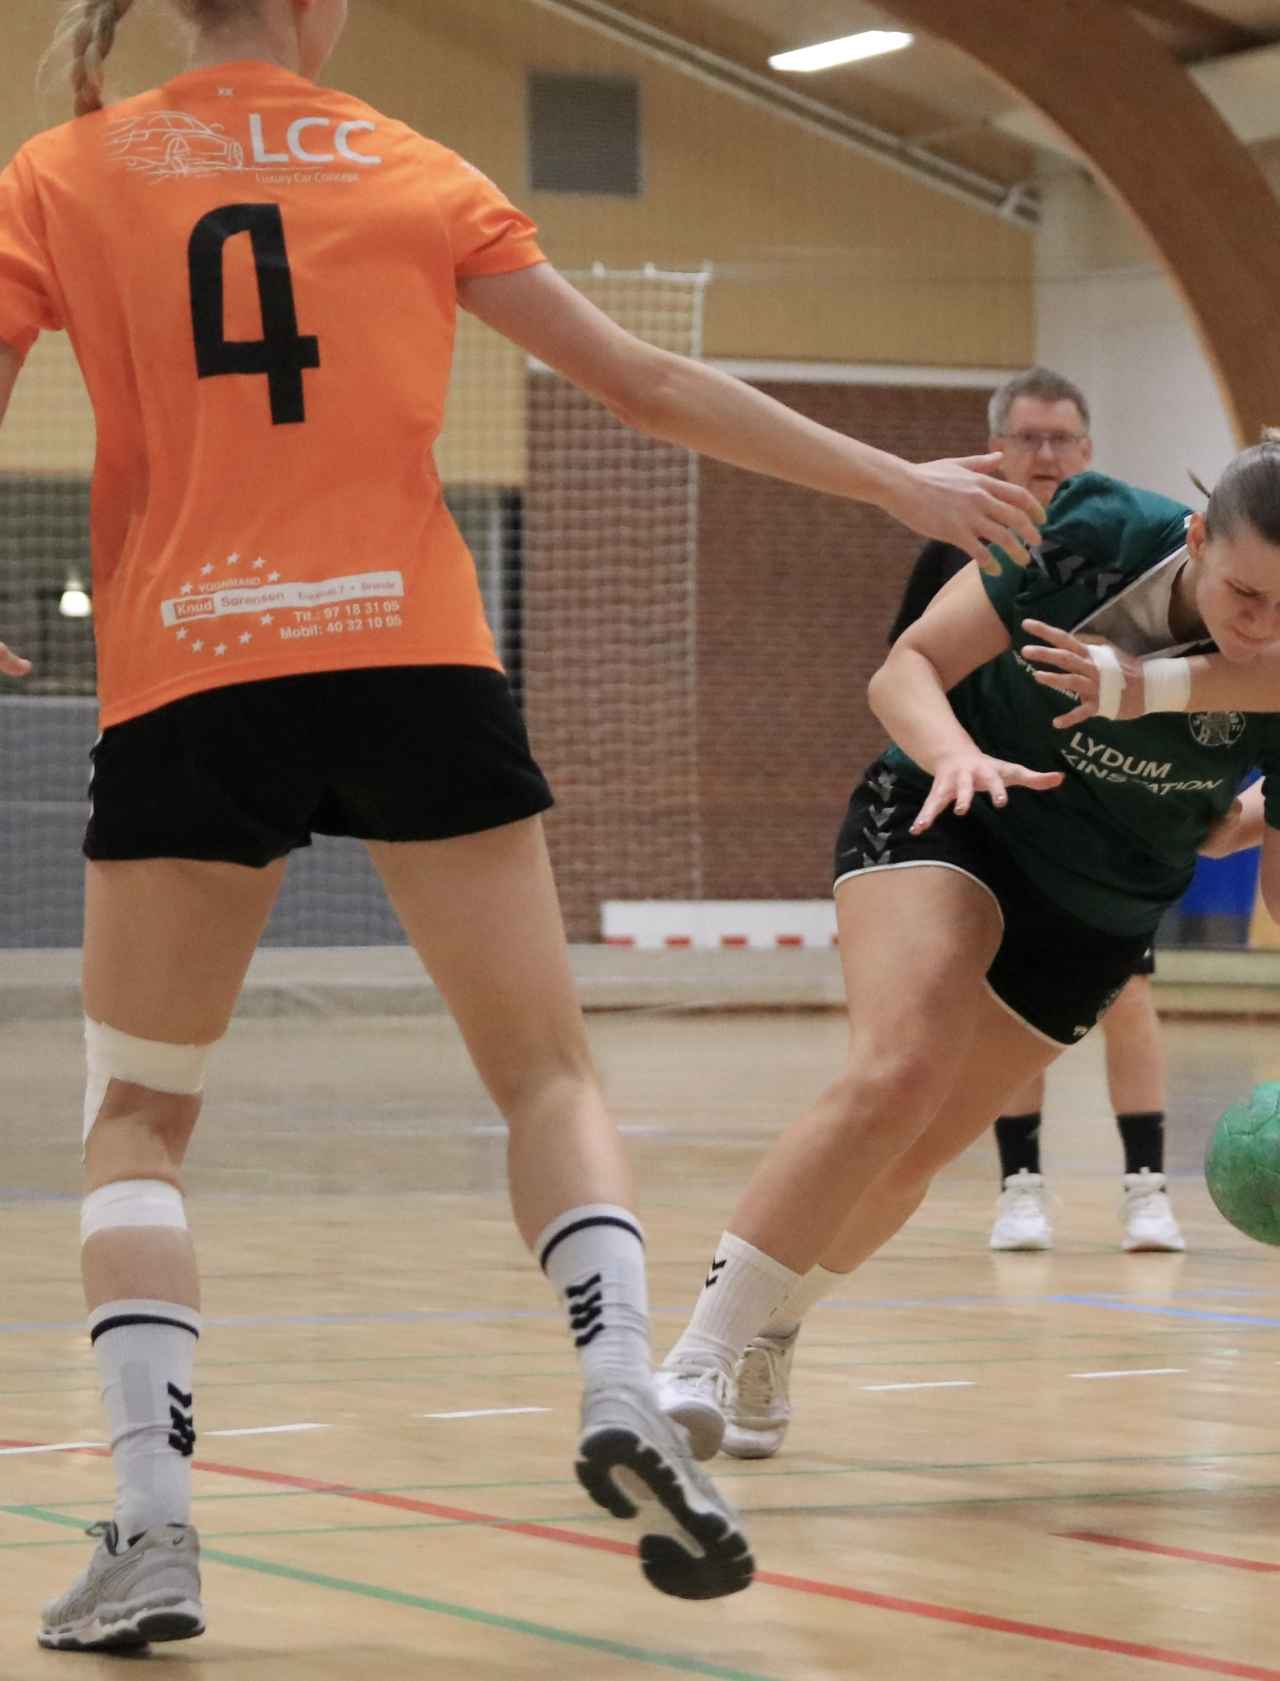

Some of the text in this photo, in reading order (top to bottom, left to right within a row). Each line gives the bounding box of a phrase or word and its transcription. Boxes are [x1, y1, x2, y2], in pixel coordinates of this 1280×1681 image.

[249, 113, 381, 164] LCC
[187, 203, 319, 424] 4
[280, 624, 323, 639] Mobil:
[327, 621, 342, 633] 40
[347, 619, 362, 630] 32
[368, 616, 383, 628] 10
[1070, 732, 1172, 779] LYDUM
